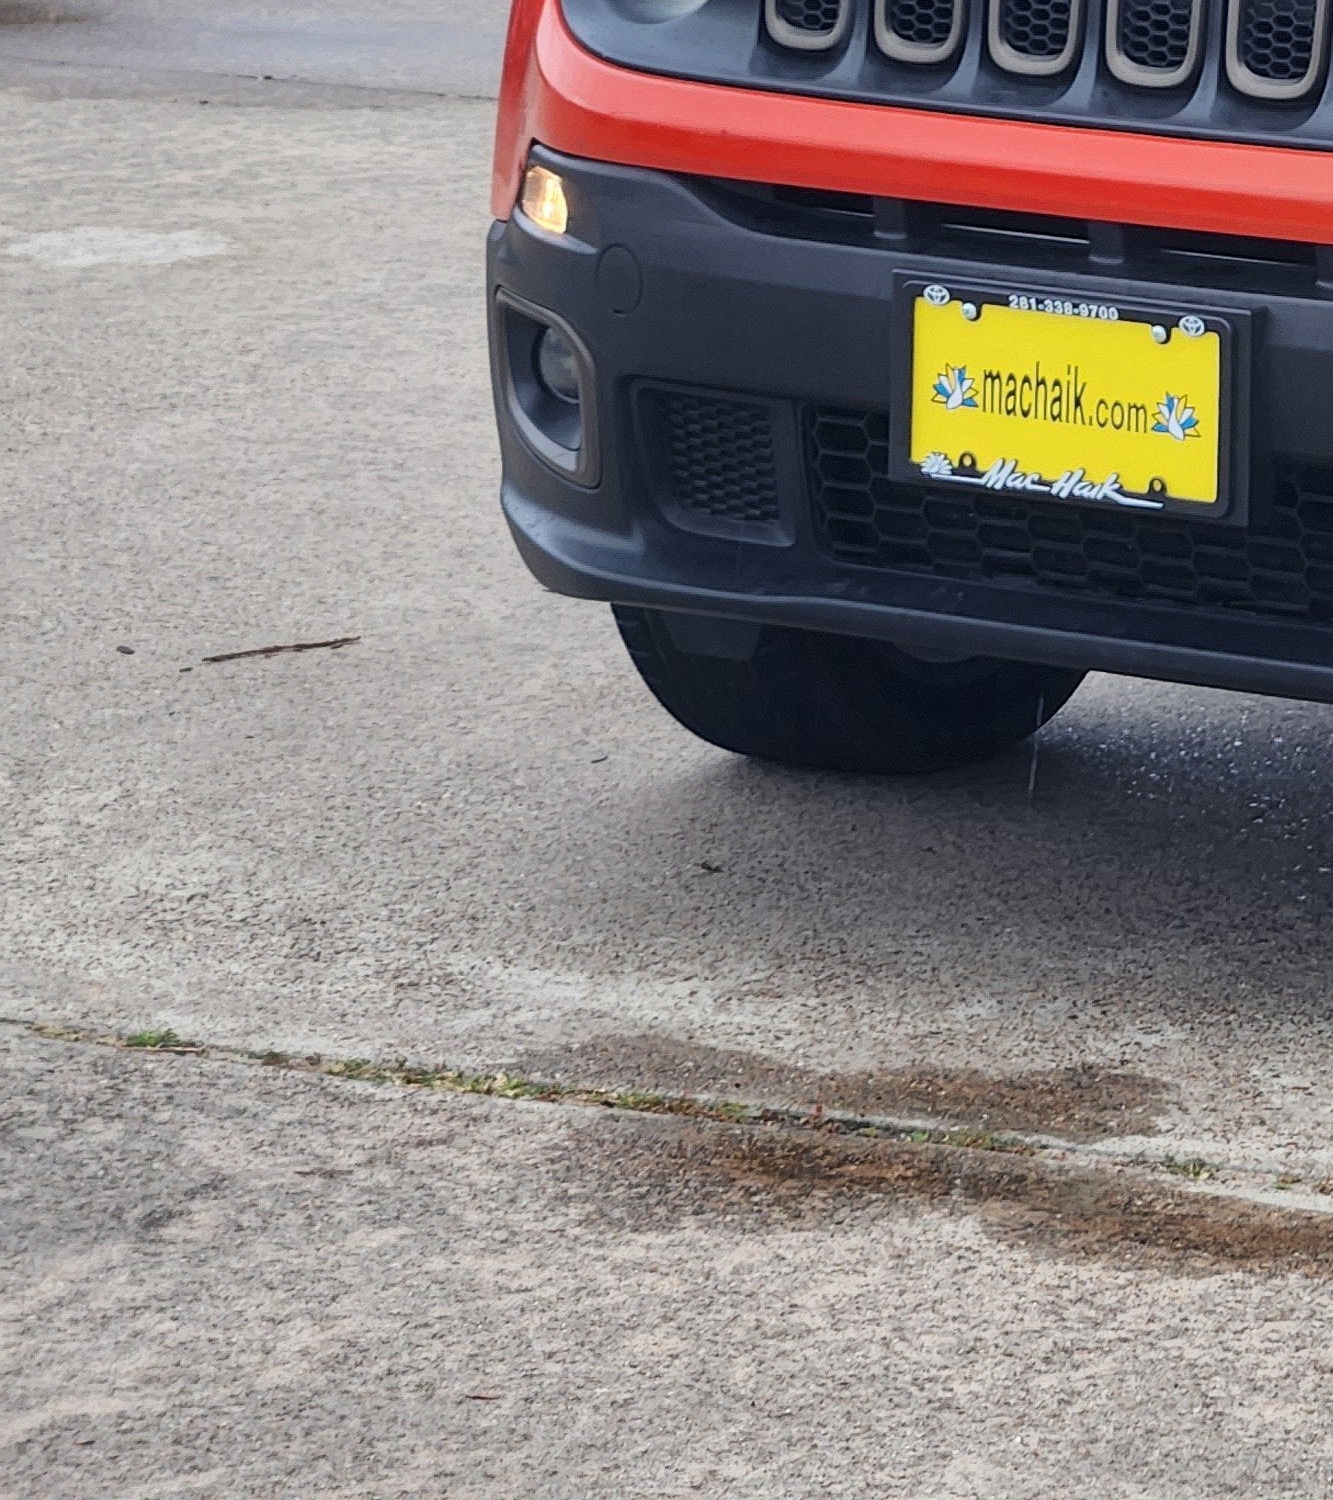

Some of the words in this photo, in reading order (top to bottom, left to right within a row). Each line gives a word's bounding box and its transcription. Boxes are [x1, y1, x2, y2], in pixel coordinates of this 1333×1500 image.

[1008, 294, 1119, 321] 281-338-9700
[982, 361, 1148, 433] machaik.com
[977, 457, 1050, 492] Mac
[1050, 467, 1140, 504] Haik
